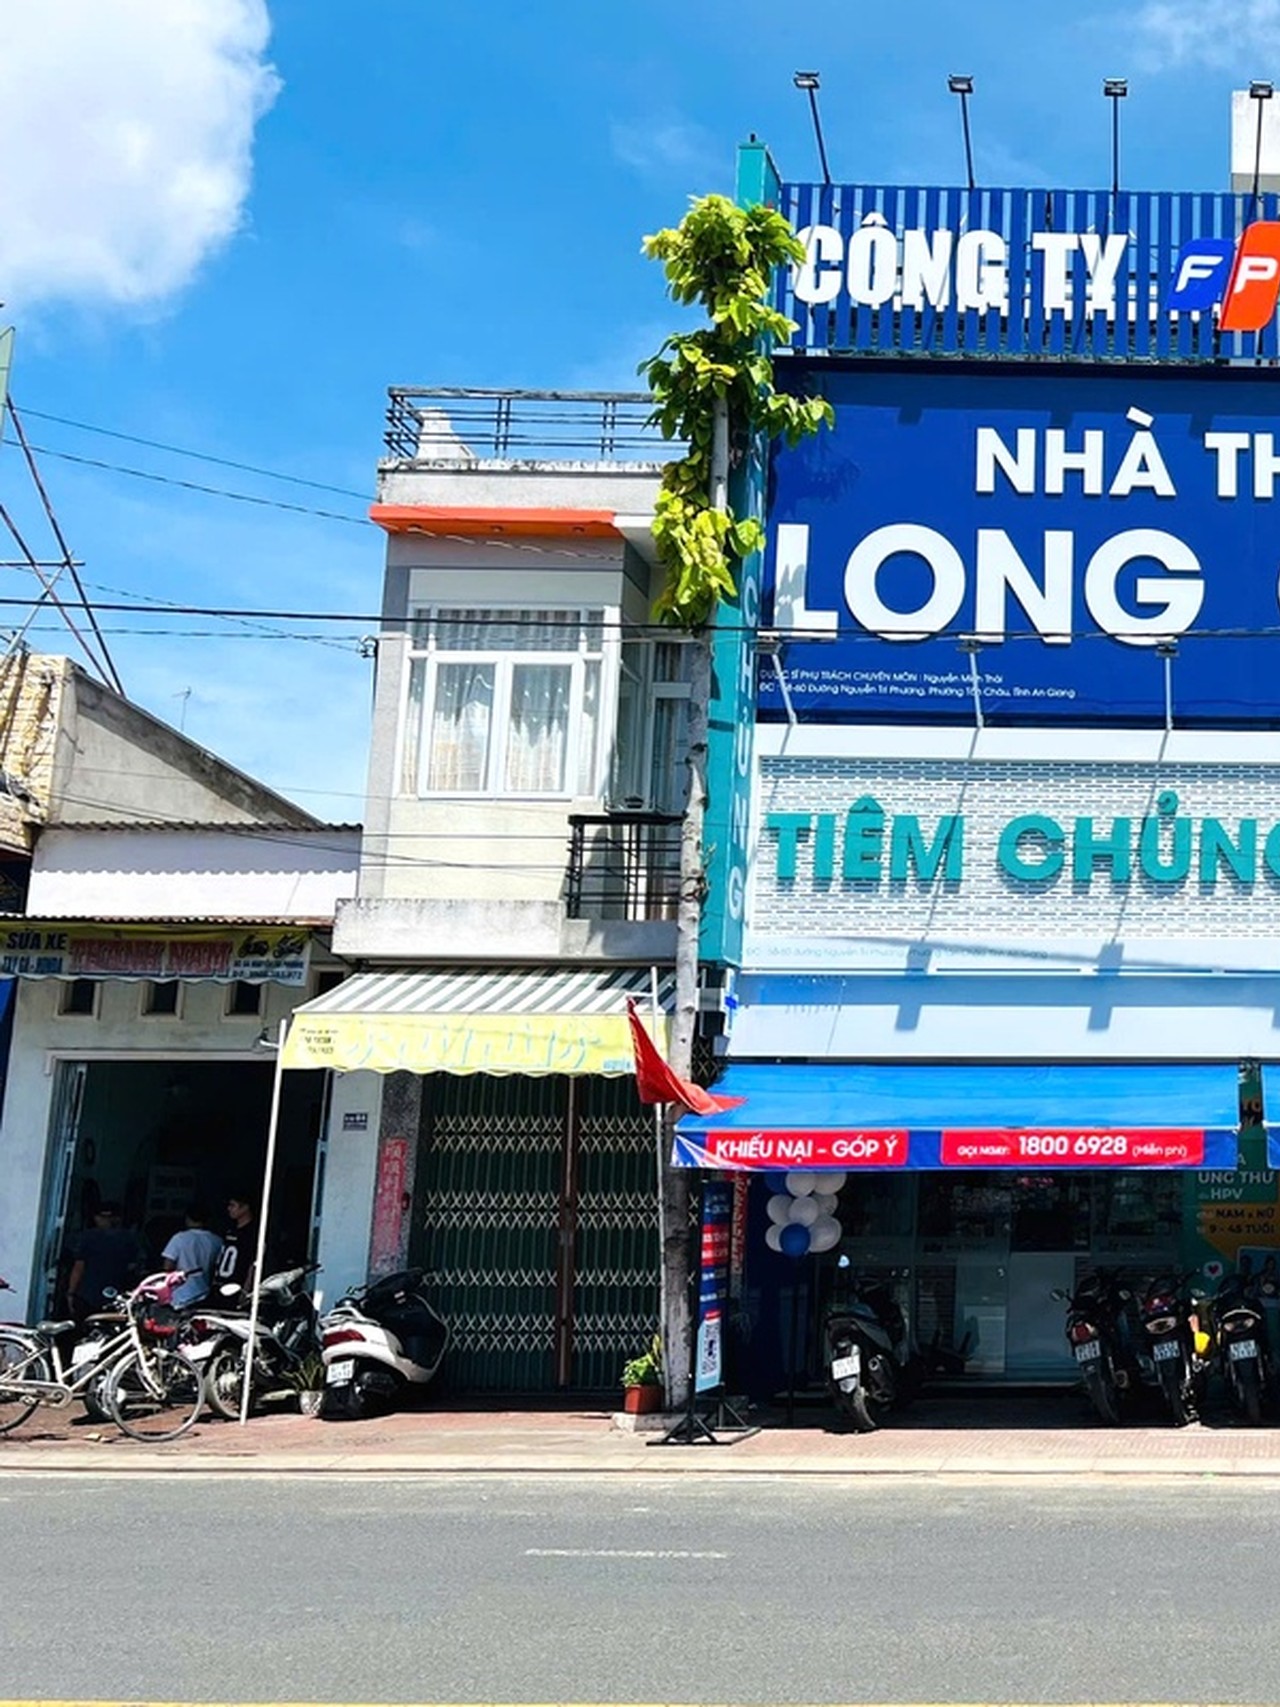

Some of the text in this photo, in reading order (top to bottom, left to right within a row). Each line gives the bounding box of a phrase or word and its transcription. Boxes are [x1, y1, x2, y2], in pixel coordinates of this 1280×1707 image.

[793, 211, 1007, 309] CÔNG
[1031, 231, 1128, 309] TY
[974, 406, 1177, 496] NHÀ
[772, 522, 1205, 647] LONG
[766, 794, 966, 882] TIÊM
[6, 927, 69, 950] SỬA XE
[715, 1133, 774, 1159] KHIẾU
[776, 1139, 813, 1164] NẠI
[831, 1134, 880, 1158] GÓP
[884, 1134, 898, 1157] Ý
[1018, 1135, 1069, 1156] 1800
[1074, 1136, 1128, 1156] 6928
[1210, 1187, 1243, 1200] HPV
